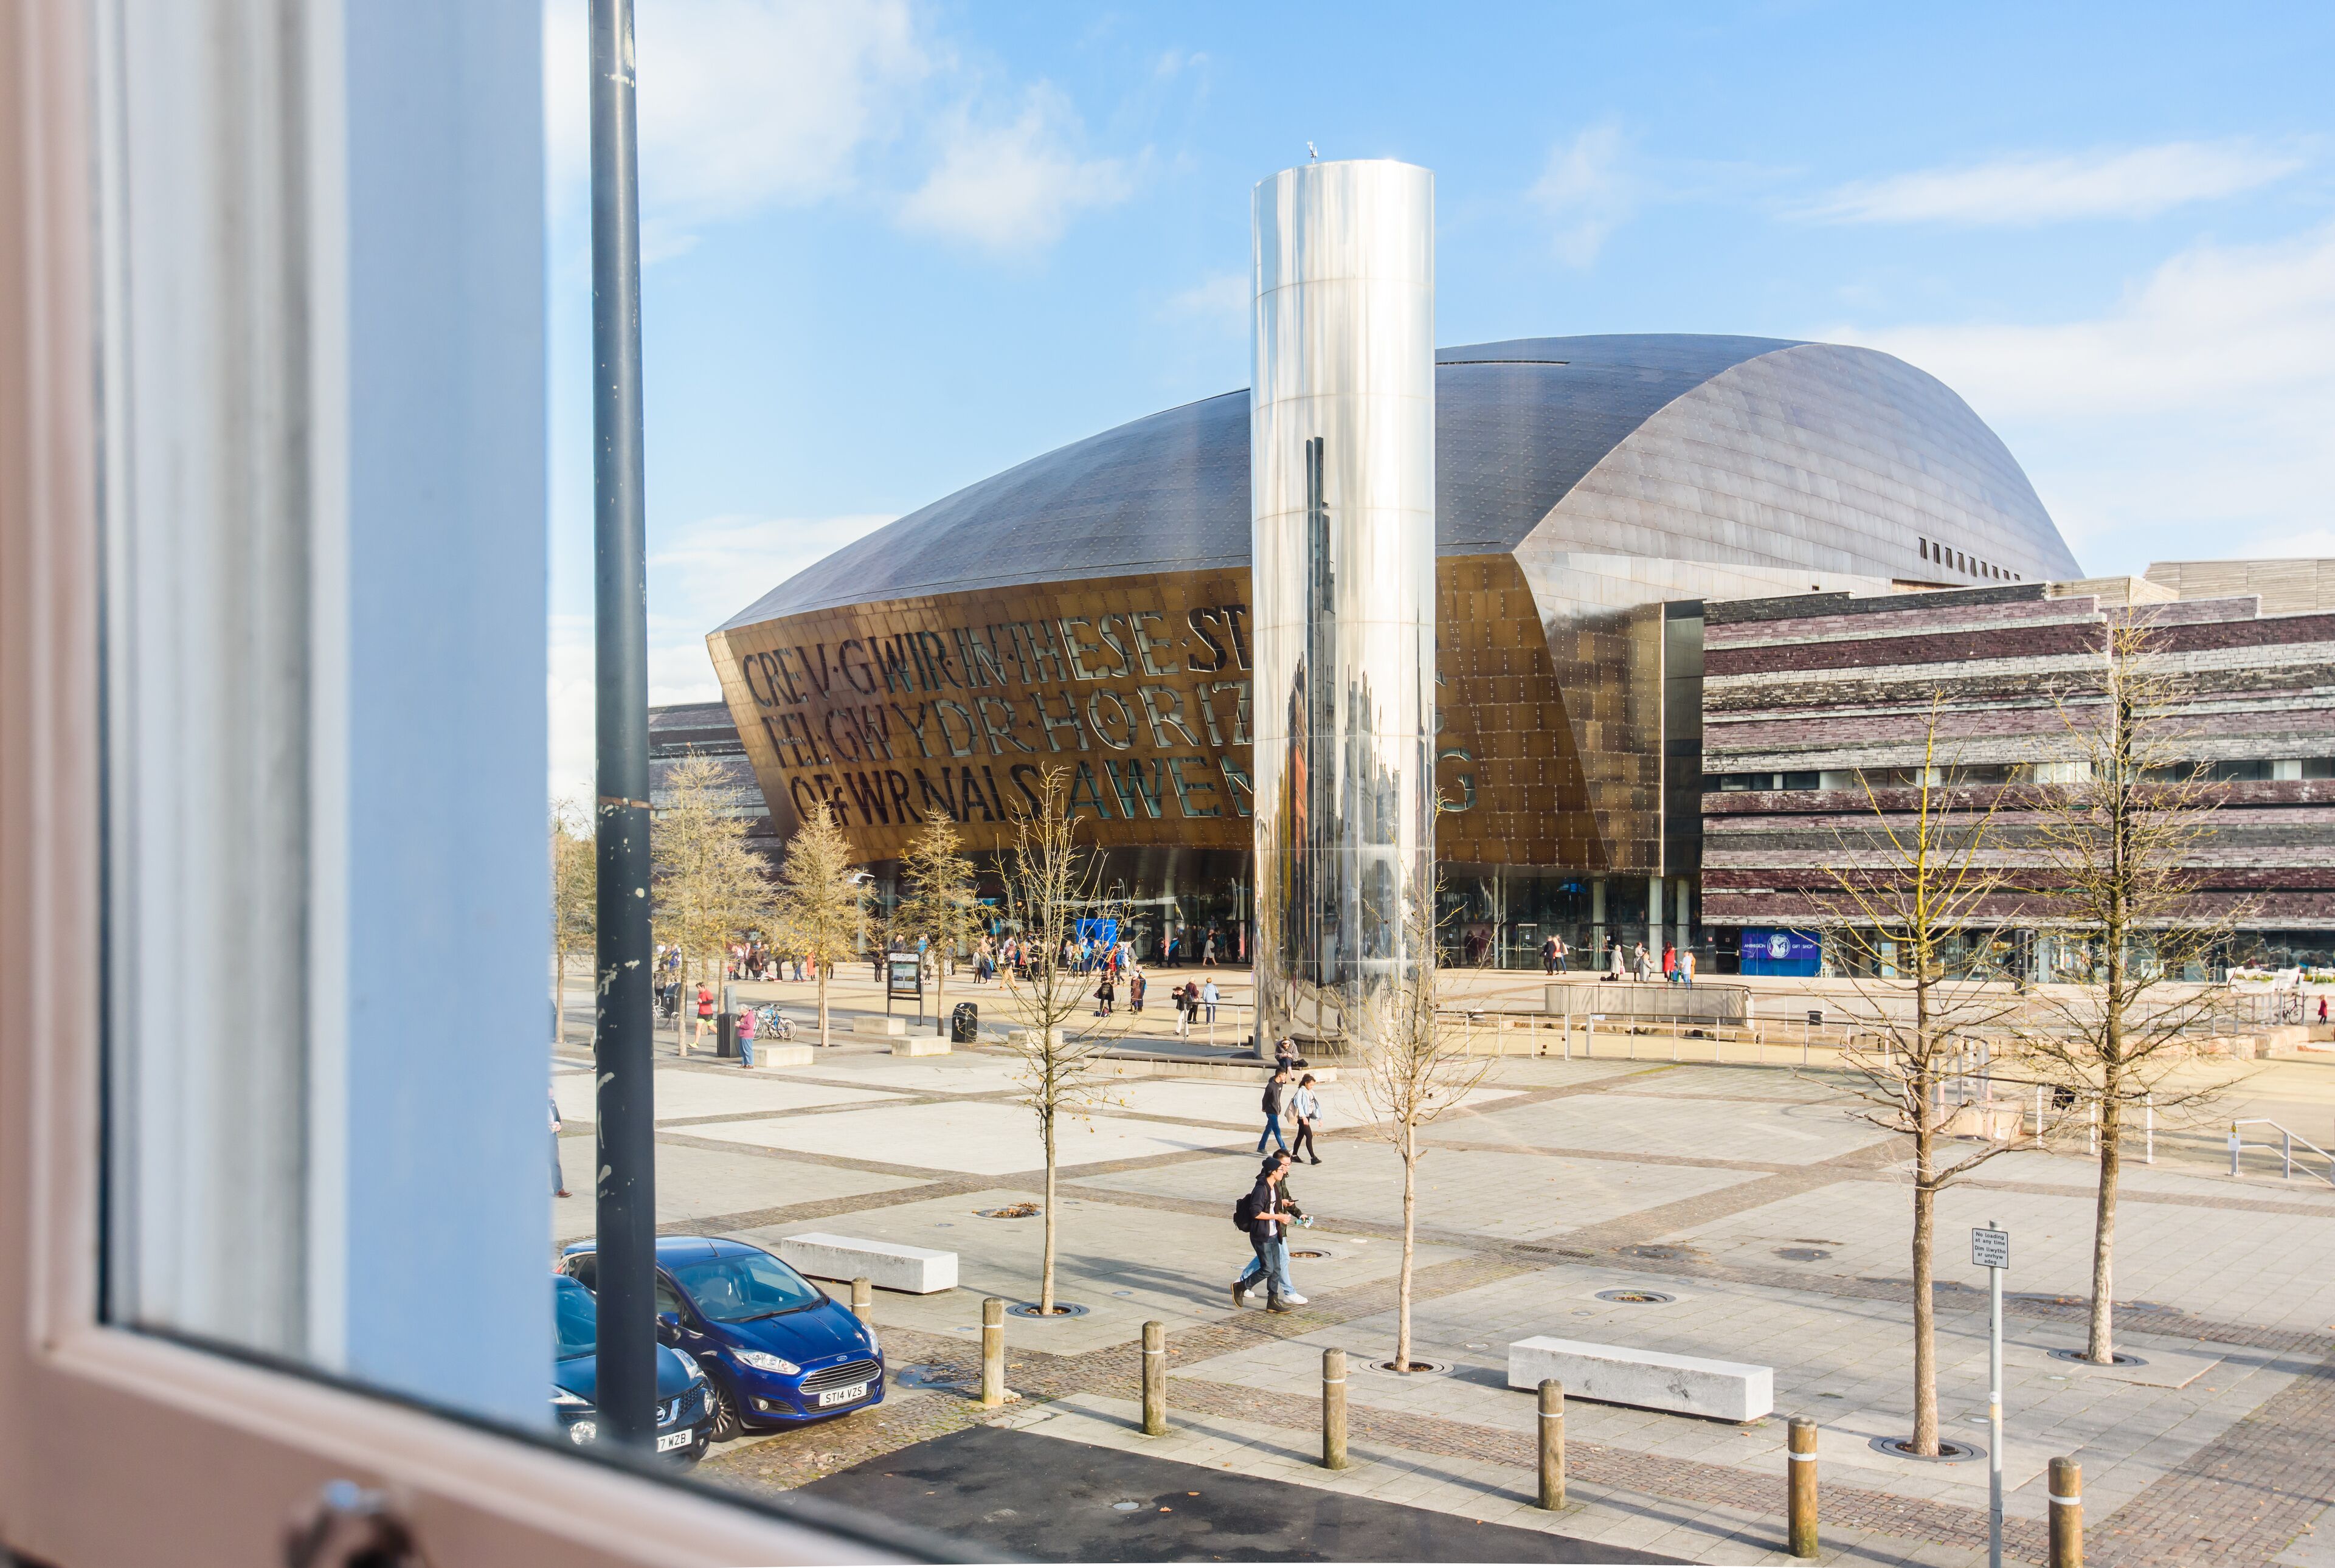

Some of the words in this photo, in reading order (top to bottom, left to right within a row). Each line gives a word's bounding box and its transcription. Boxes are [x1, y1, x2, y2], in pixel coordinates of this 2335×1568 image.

[743, 644, 831, 708] CREV
[839, 631, 963, 696] GWIR
[999, 610, 1180, 685] THESE
[1029, 680, 1251, 753] HORIZ
[826, 1390, 844, 1403] ST14
[848, 1386, 862, 1398] VZS
[669, 1433, 686, 1447] WZB
